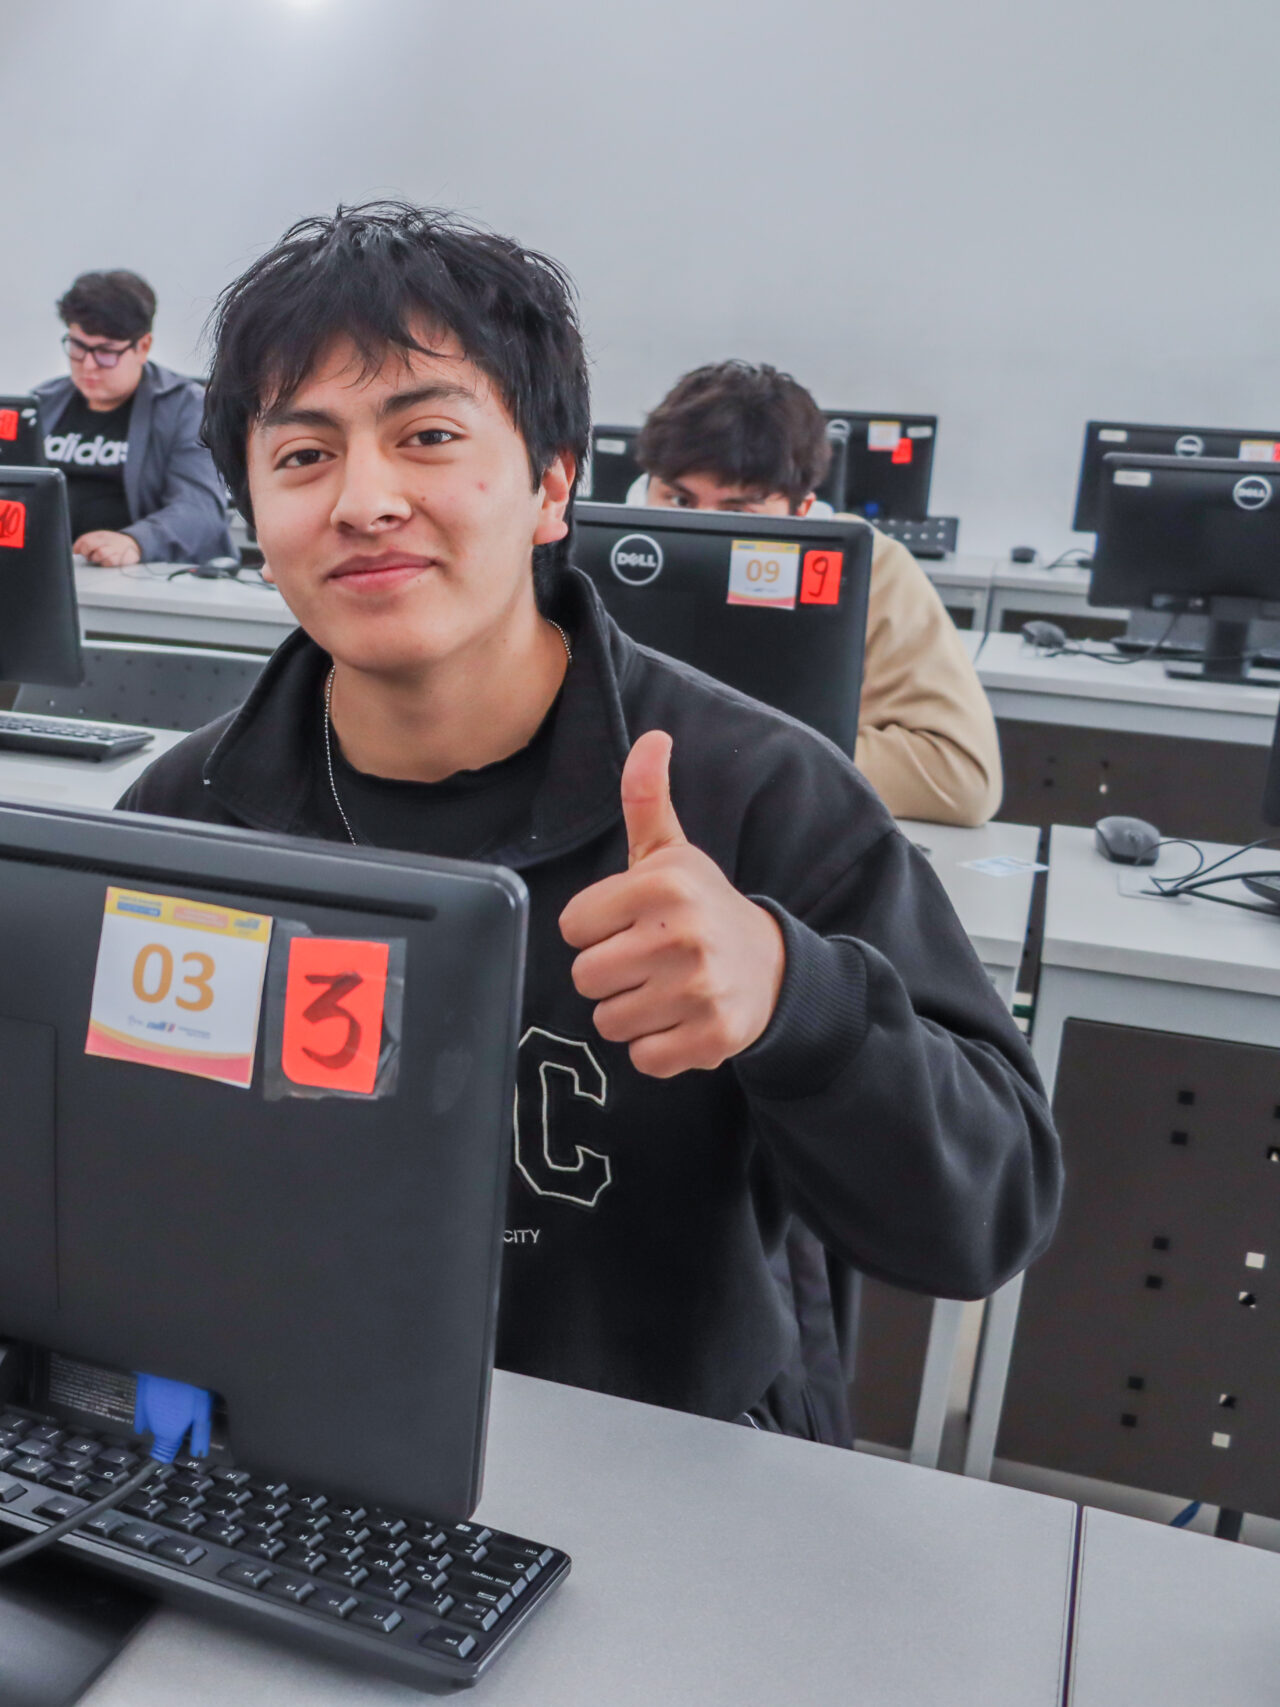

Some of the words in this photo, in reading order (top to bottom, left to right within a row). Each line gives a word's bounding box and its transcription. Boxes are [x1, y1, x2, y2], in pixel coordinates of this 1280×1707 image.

[616, 551, 657, 568] DELL
[746, 558, 780, 583] 09
[807, 556, 829, 598] 9
[131, 942, 216, 1013] 03
[301, 971, 364, 1070] 3
[513, 1026, 612, 1208] C
[503, 1229, 540, 1244] CITY
